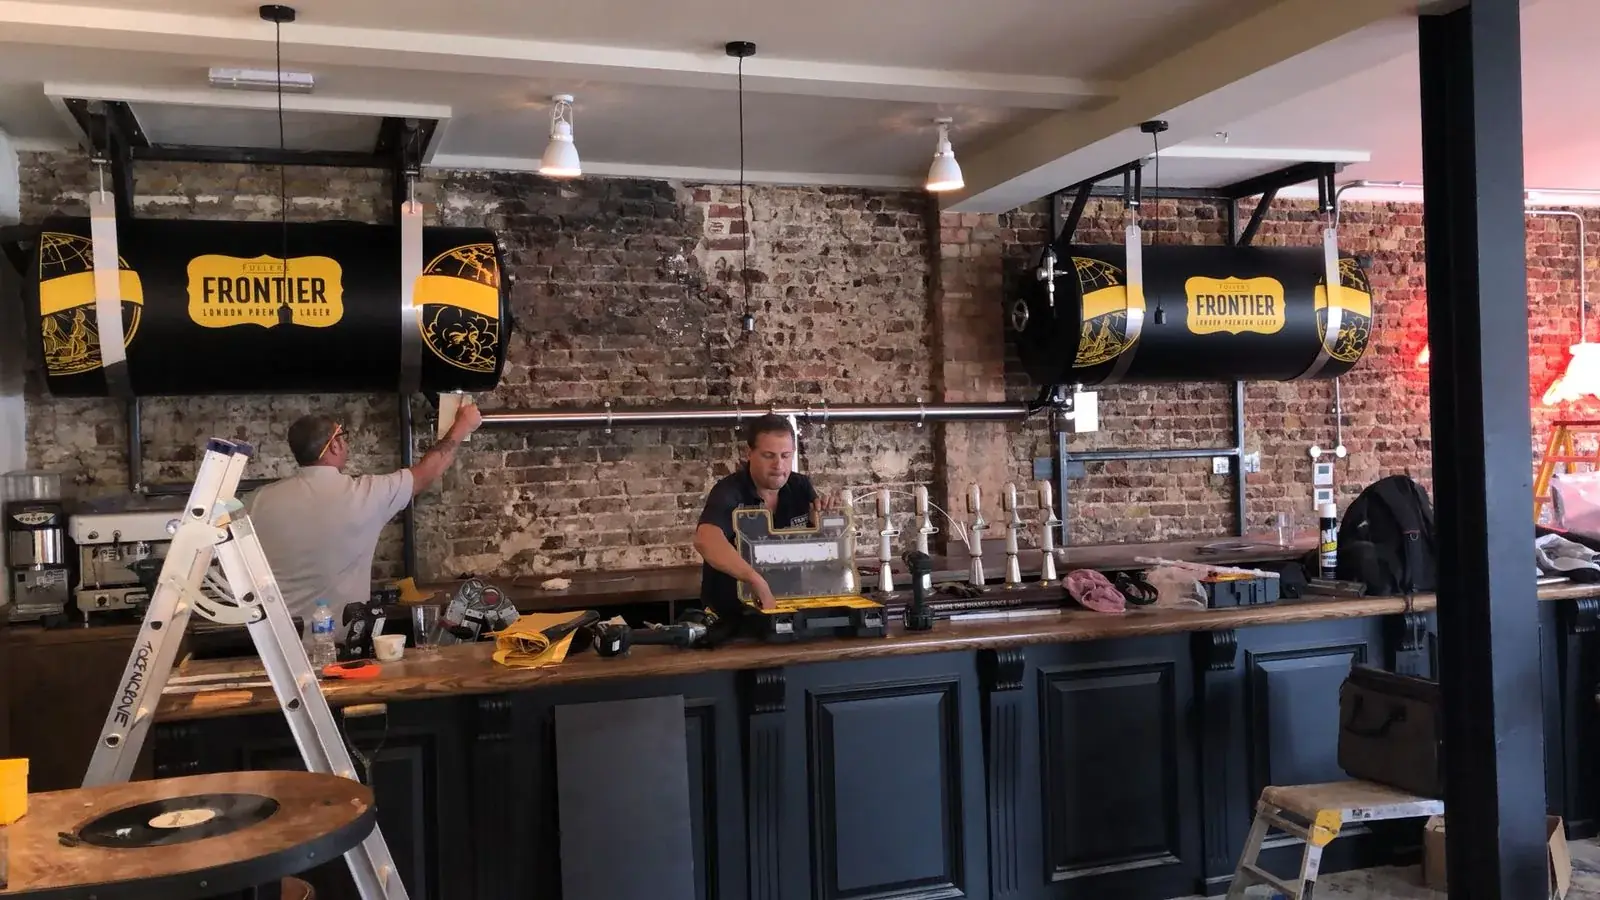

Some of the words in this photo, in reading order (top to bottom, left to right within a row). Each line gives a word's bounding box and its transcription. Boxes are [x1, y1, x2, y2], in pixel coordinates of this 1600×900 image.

[203, 276, 327, 304] FRONTIER
[203, 308, 243, 317] LONDON
[248, 308, 275, 317] PREM
[300, 308, 331, 317] LAGER
[1196, 294, 1275, 316] FRONTIER
